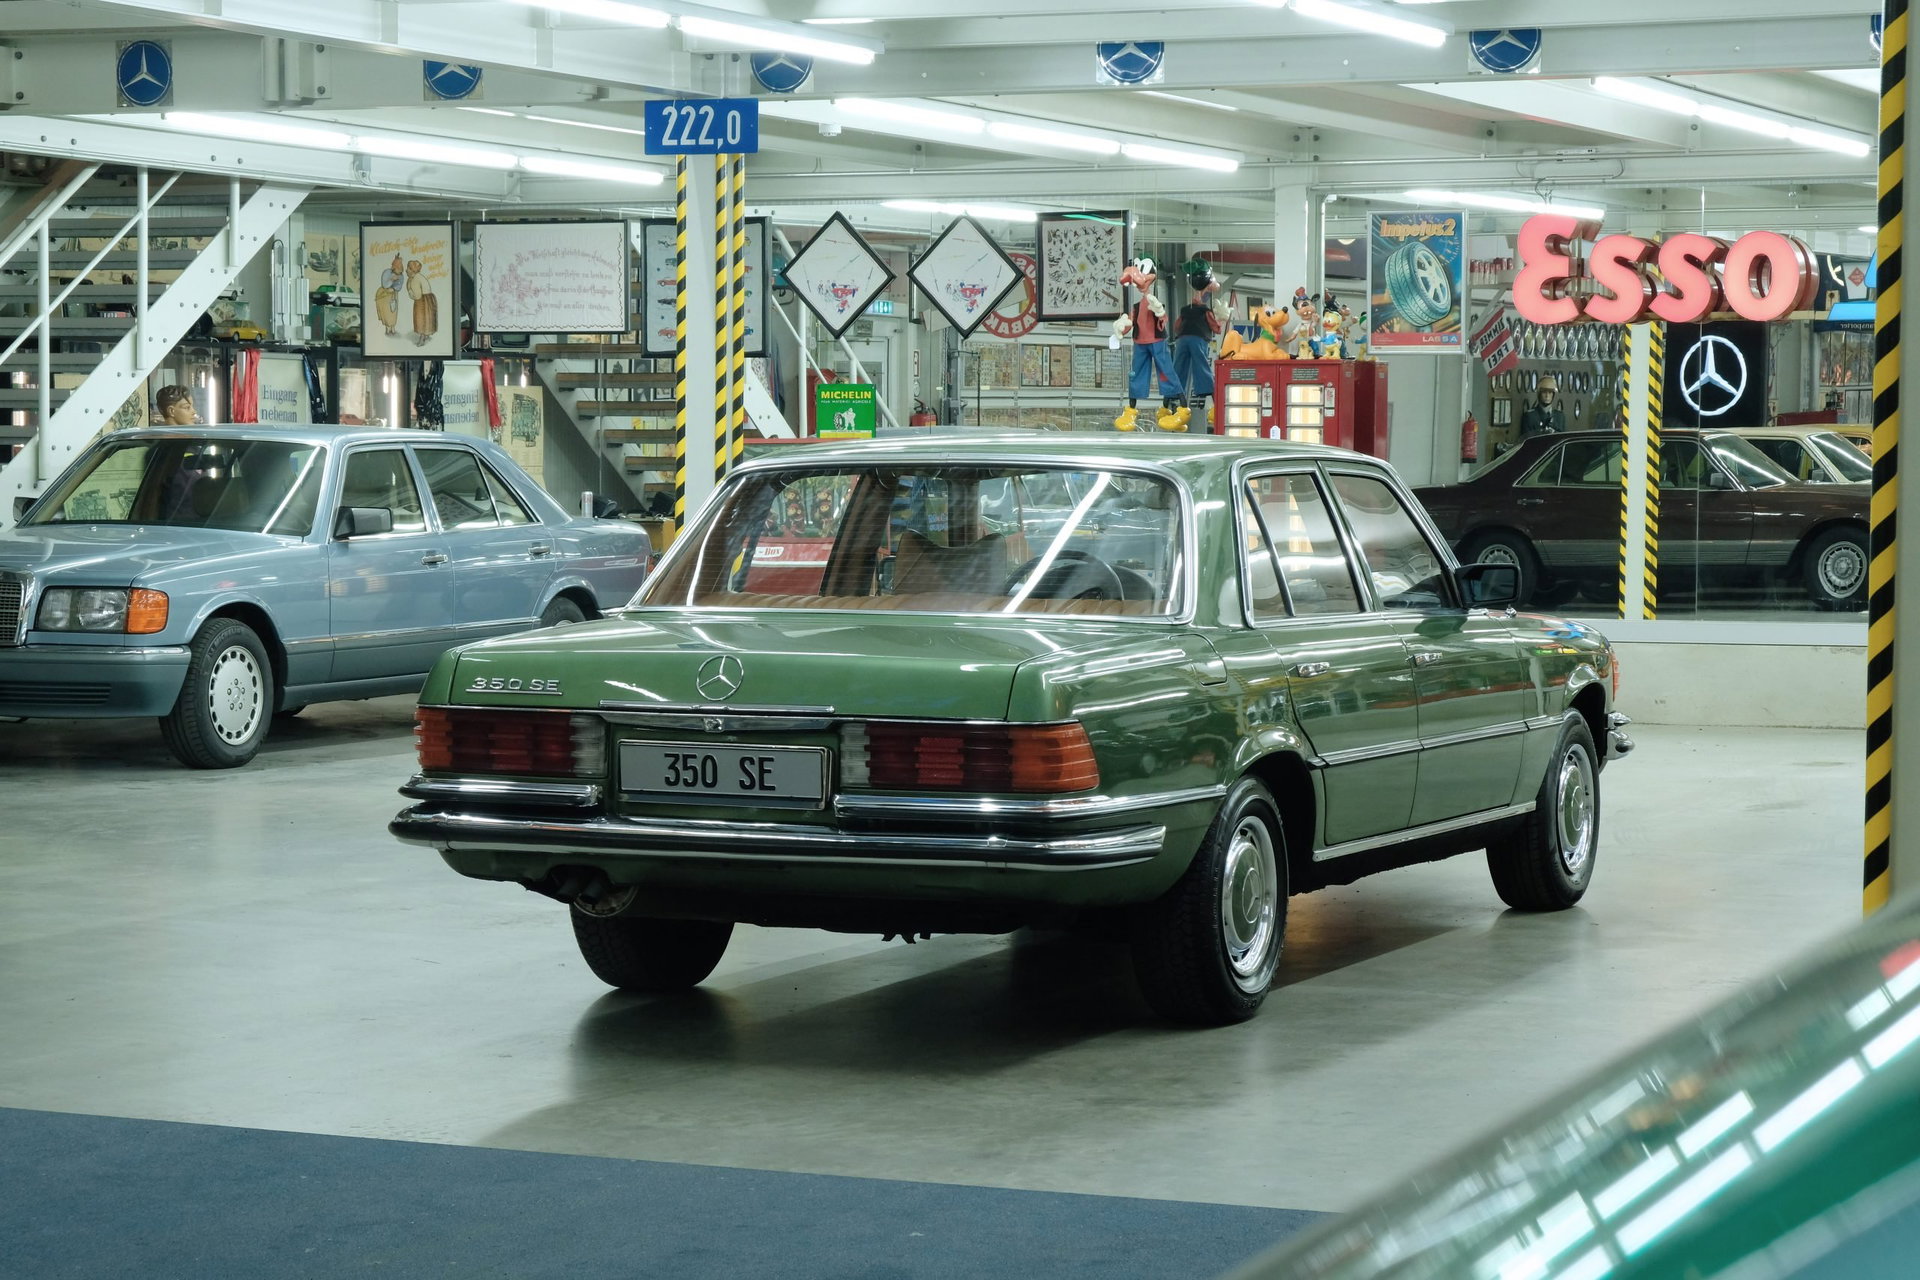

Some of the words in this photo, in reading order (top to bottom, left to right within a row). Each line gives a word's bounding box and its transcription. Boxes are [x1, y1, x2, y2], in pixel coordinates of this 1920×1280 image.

[662, 105, 741, 149] 222,0
[1422, 335, 1458, 343] LASSA
[262, 385, 298, 407] Eingang
[820, 390, 872, 399] MICHELIN
[261, 408, 298, 421] nebenan
[471, 677, 523, 691] 350
[529, 678, 560, 692] SE
[664, 752, 718, 788] 350
[738, 756, 776, 791] SE
